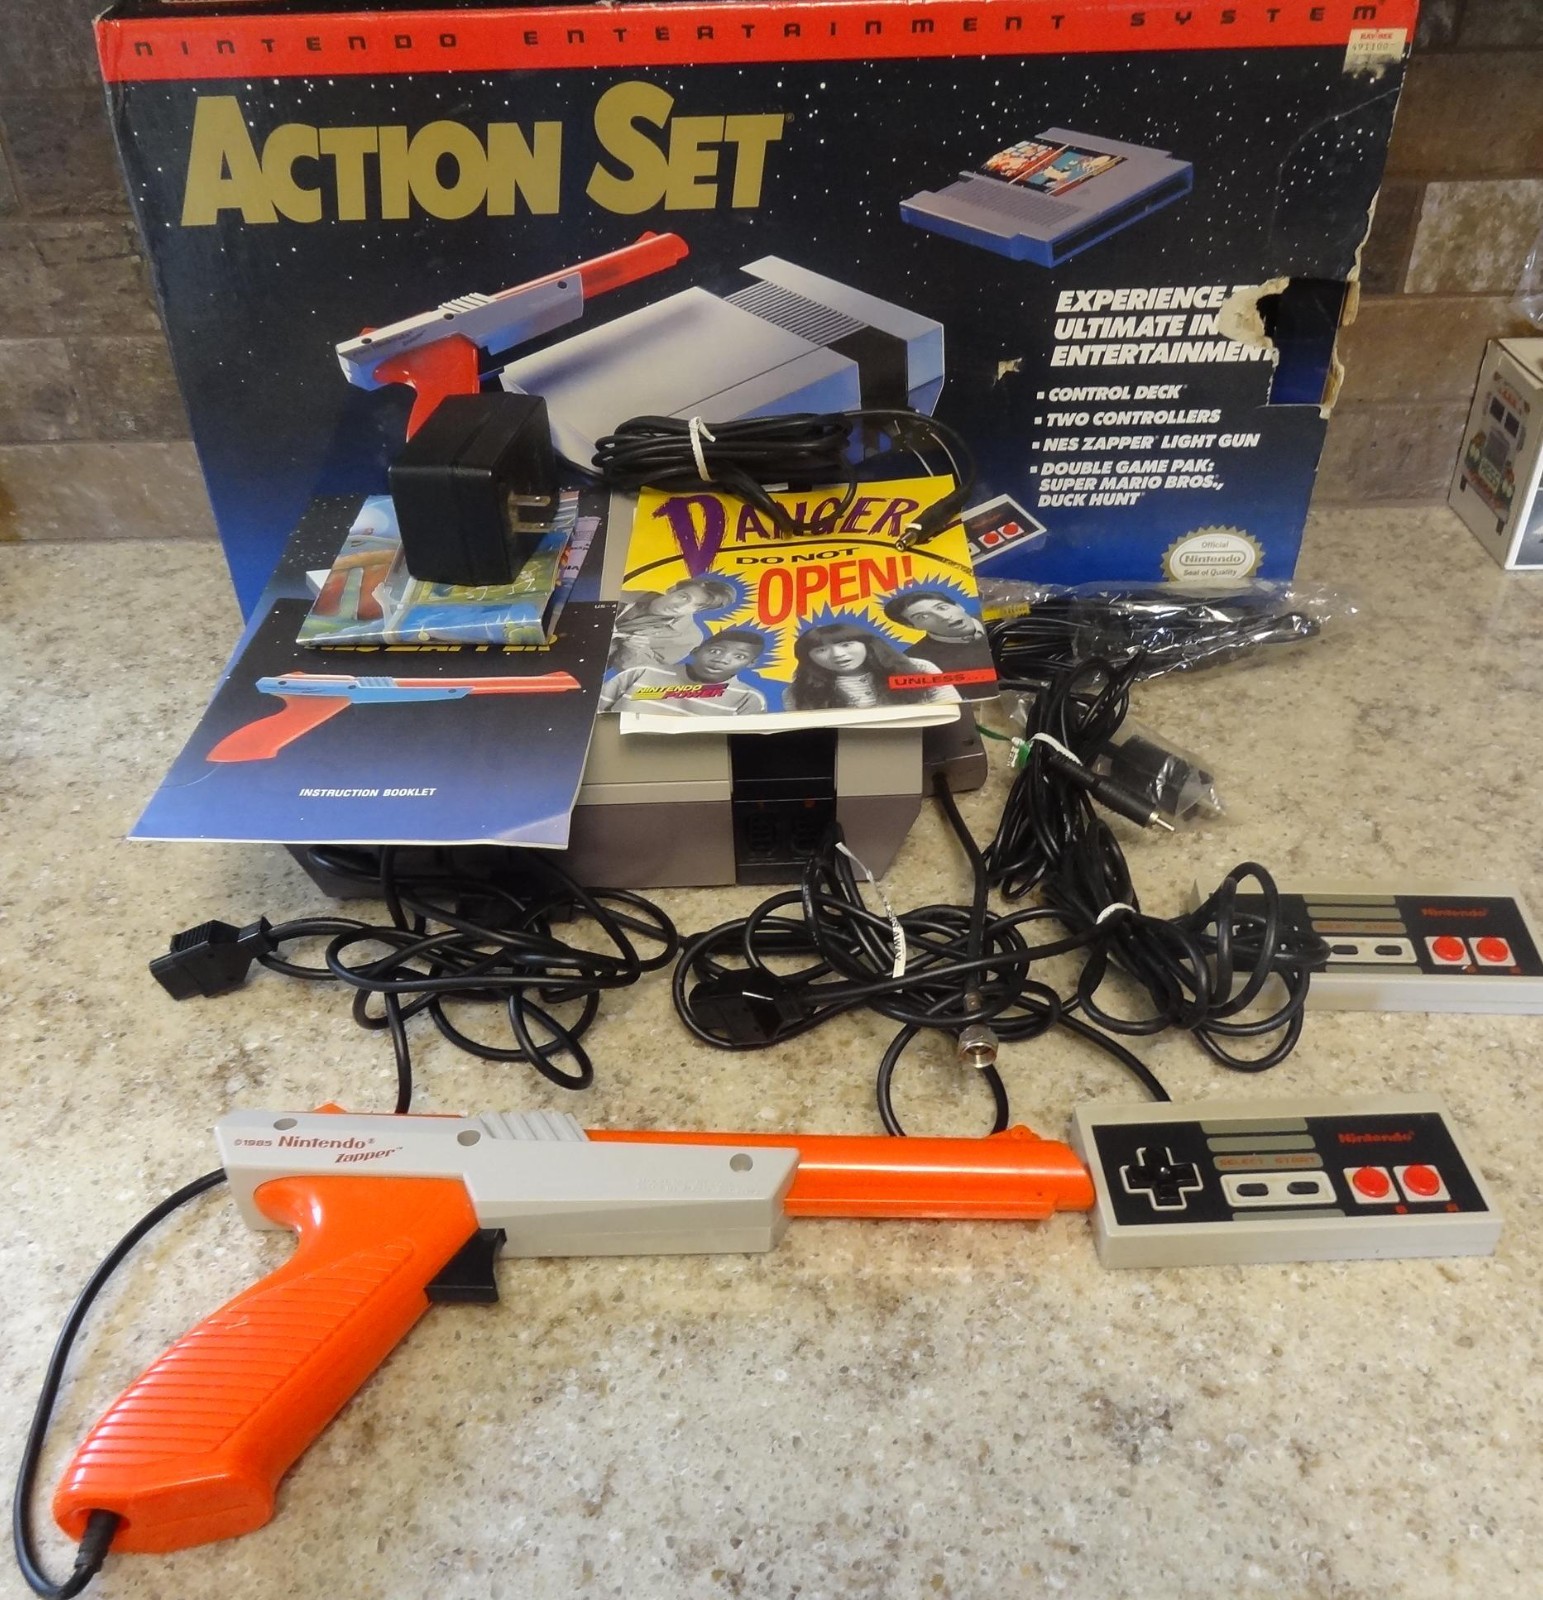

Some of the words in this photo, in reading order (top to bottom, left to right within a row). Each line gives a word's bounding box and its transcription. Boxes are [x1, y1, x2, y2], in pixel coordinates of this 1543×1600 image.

[134, 34, 457, 57] NINTENDO
[523, 15, 1065, 46] ENTERTAINMENT
[1130, 6, 1376, 29] SYSTEM
[180, 96, 562, 226] ACTION
[586, 81, 784, 215] SET
[1055, 285, 1226, 312] EXPERIENCE
[1053, 315, 1184, 340] ULTIMATE
[1188, 314, 1220, 336] IN
[1048, 386, 1131, 402] CONTROL
[1133, 384, 1183, 400] DECK
[1046, 413, 1090, 427] TWO
[1092, 409, 1221, 426] CONTROLLERS
[1043, 437, 1079, 452] NES
[1081, 436, 1154, 451] ZAPPER
[1160, 434, 1217, 449] LIGHT
[1218, 433, 1261, 448] GUN
[1040, 462, 1115, 476] DOUBLE
[1115, 460, 1168, 474] GAME
[1170, 459, 1215, 473] PAK:
[1039, 477, 1098, 492] SUPER
[1099, 476, 1162, 491] MARIO
[1038, 493, 1088, 507] DUCK
[1089, 492, 1141, 506] HUNT
[652, 494, 920, 579] DANGER
[1201, 541, 1230, 549] Official
[736, 555, 785, 565] DO
[791, 547, 861, 563] NOT
[1184, 555, 1242, 563] Nintendo
[1184, 568, 1200, 576] Seal
[1201, 568, 1209, 576] of
[1210, 568, 1238, 577] Quality
[757, 555, 912, 626] OPEN!
[636, 684, 703, 694] NINTENDO
[299, 788, 380, 798] INSTRUCTION
[382, 787, 438, 797] BOOKLET
[278, 1135, 367, 1150] Nintendo
[1337, 1131, 1414, 1144] Nintendo
[335, 1148, 396, 1164] Zapper
